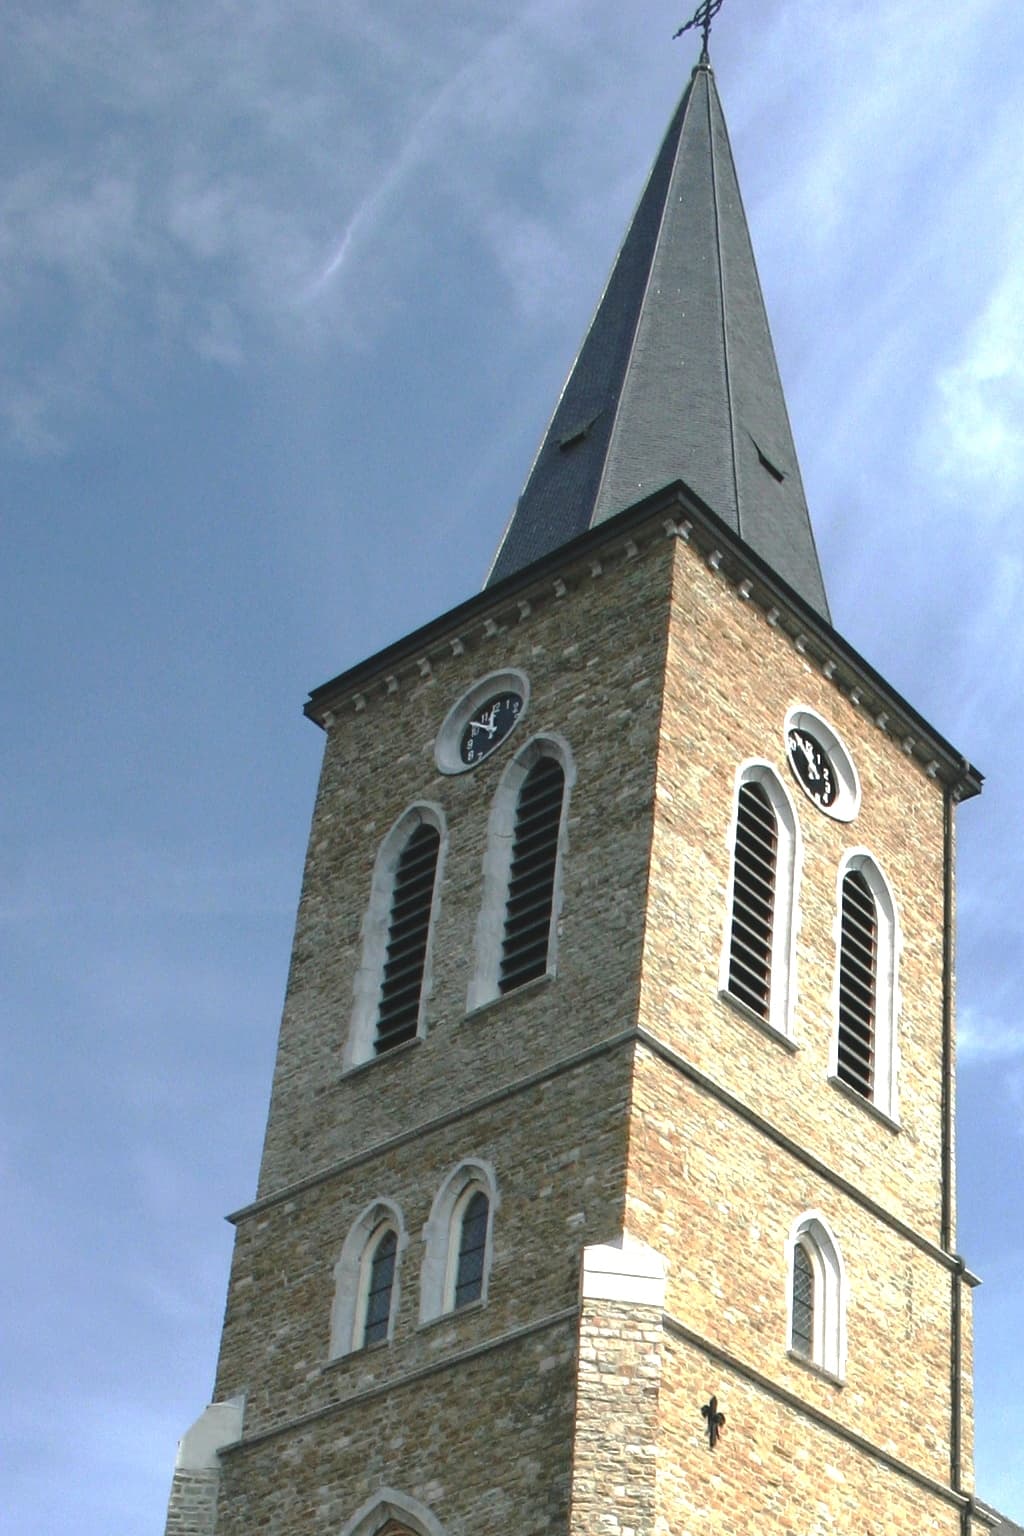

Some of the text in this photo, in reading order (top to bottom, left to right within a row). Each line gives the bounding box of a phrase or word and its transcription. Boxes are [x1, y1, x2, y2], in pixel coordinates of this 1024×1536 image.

[505, 699, 511, 710] 1
[511, 701, 519, 713] 2
[481, 711, 489, 724] 11
[816, 753, 821, 765] 1
[823, 767, 829, 780] 2
[824, 781, 831, 794] 3
